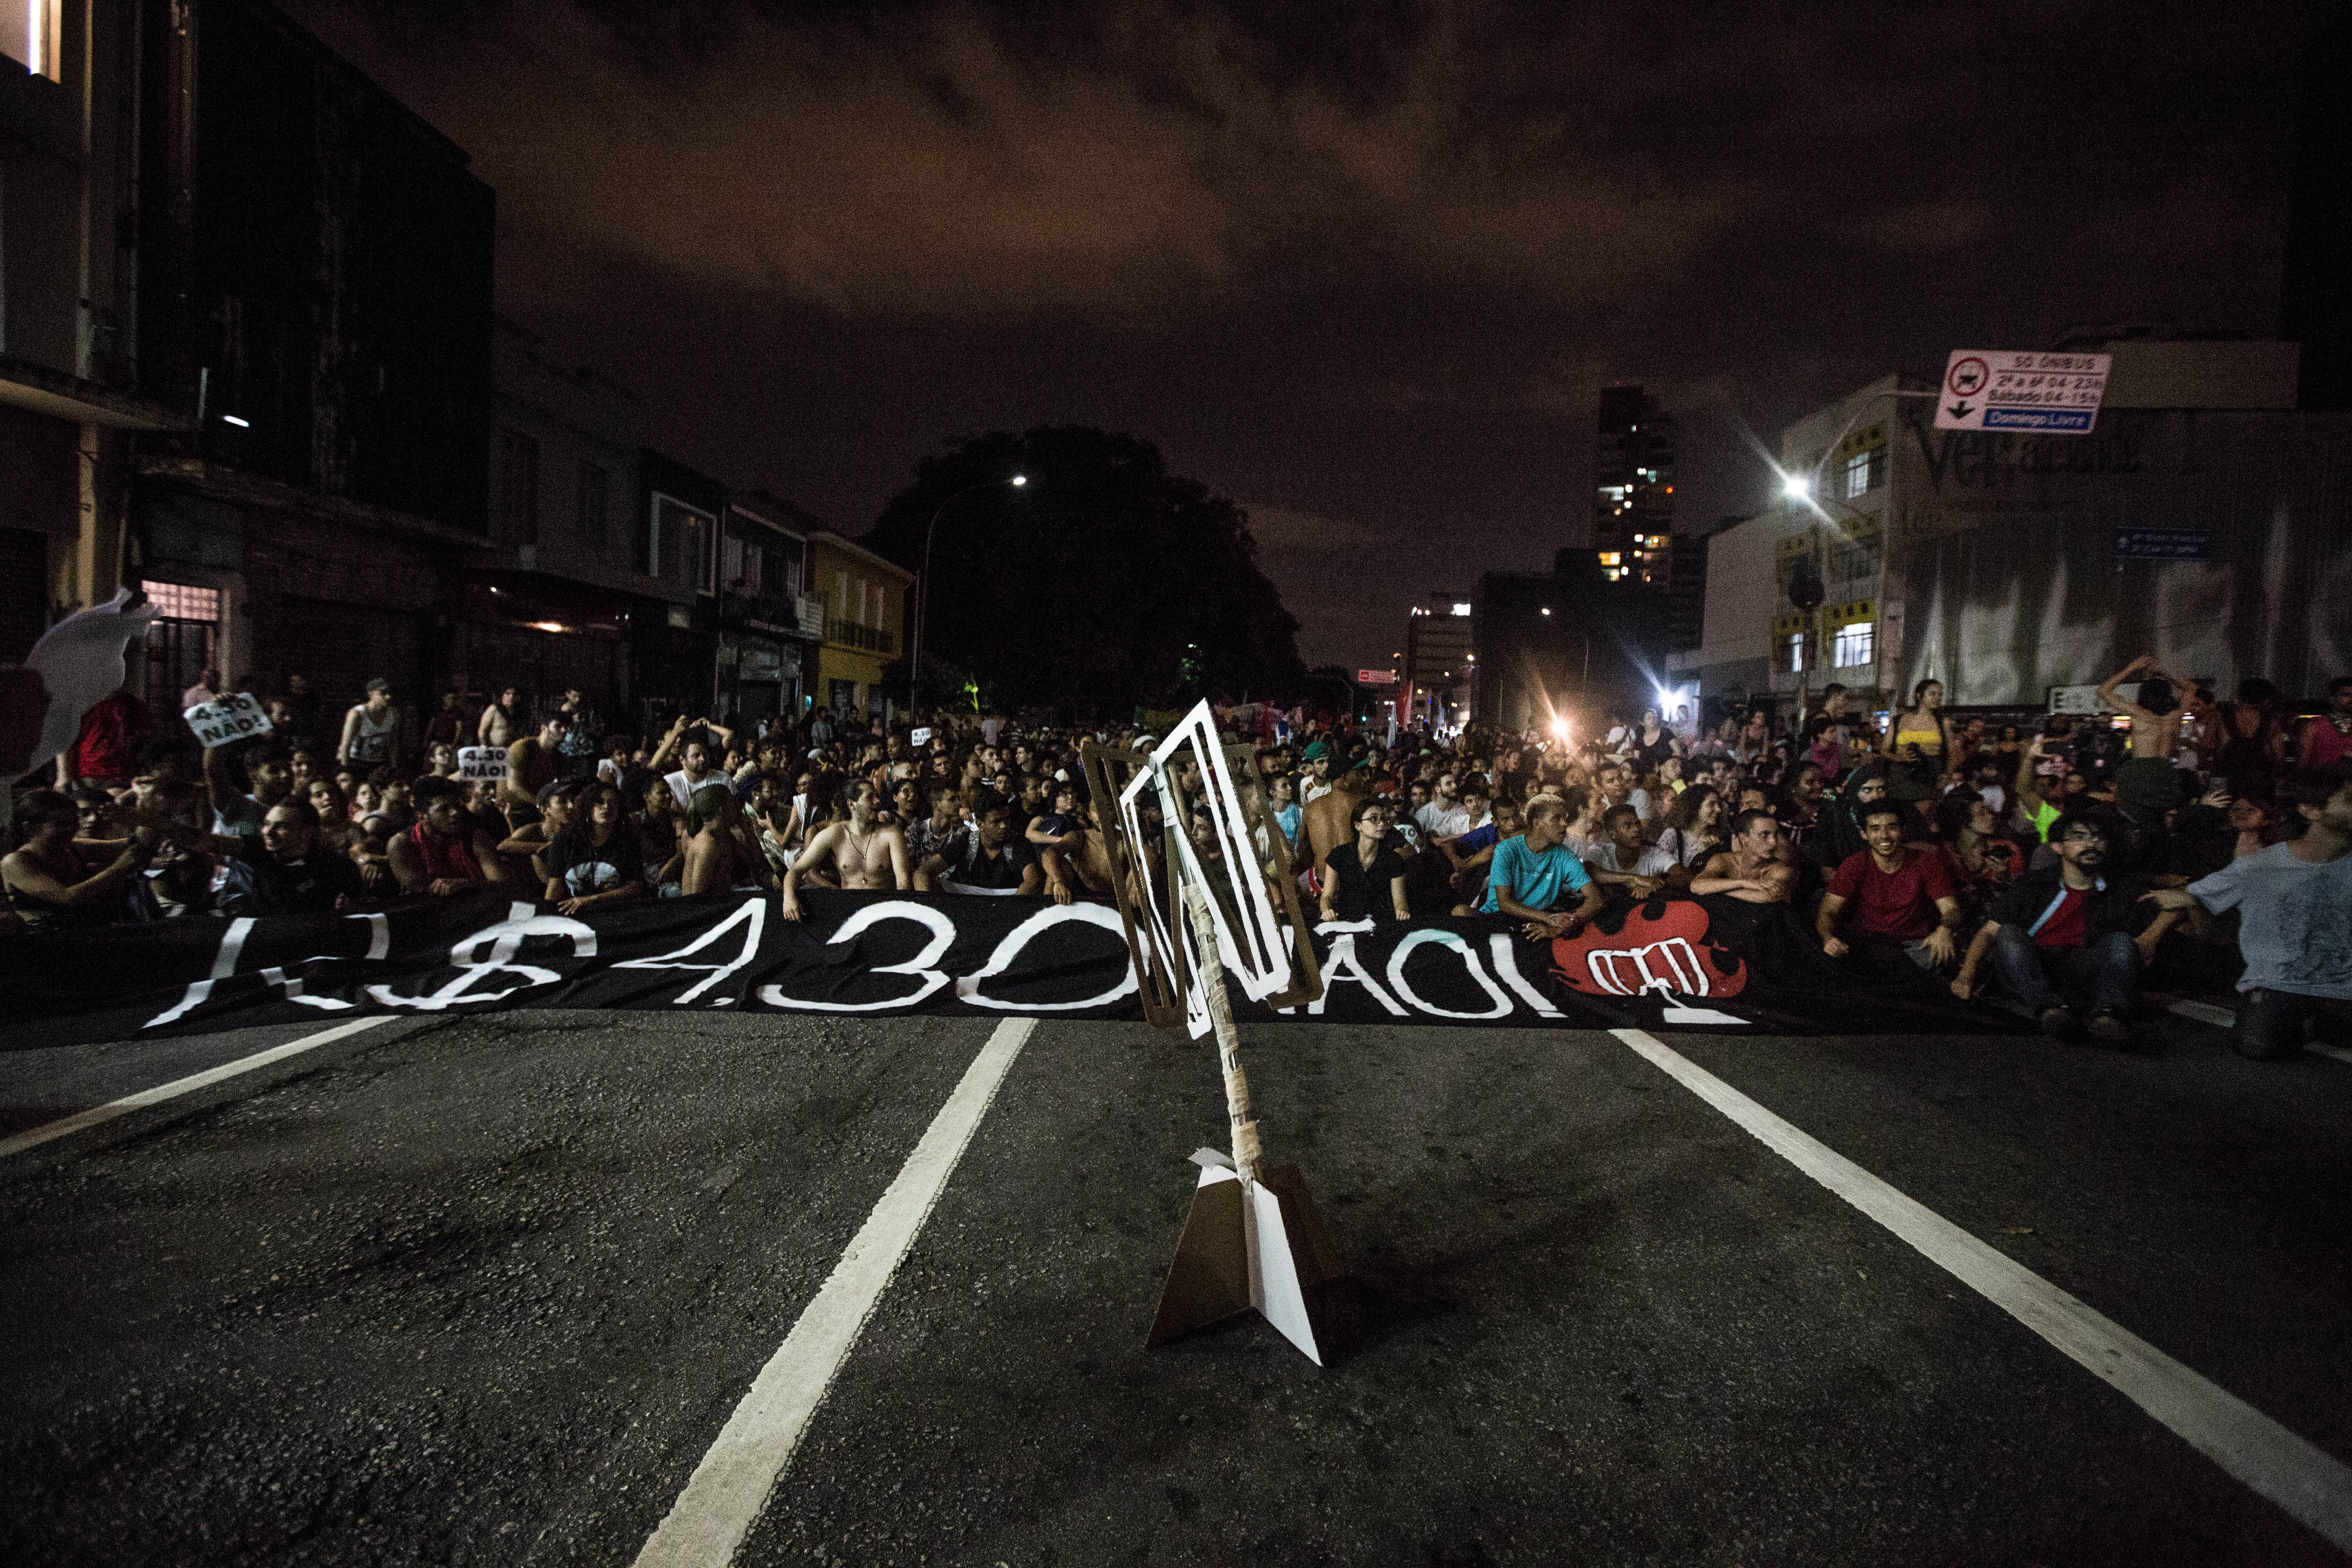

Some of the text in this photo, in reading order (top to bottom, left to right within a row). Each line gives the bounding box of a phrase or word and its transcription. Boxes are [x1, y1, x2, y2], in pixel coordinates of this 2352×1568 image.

[1991, 412, 2087, 427] Domingo Livre
[465, 750, 506, 761] 4.30
[464, 763, 506, 777] NÃO!
